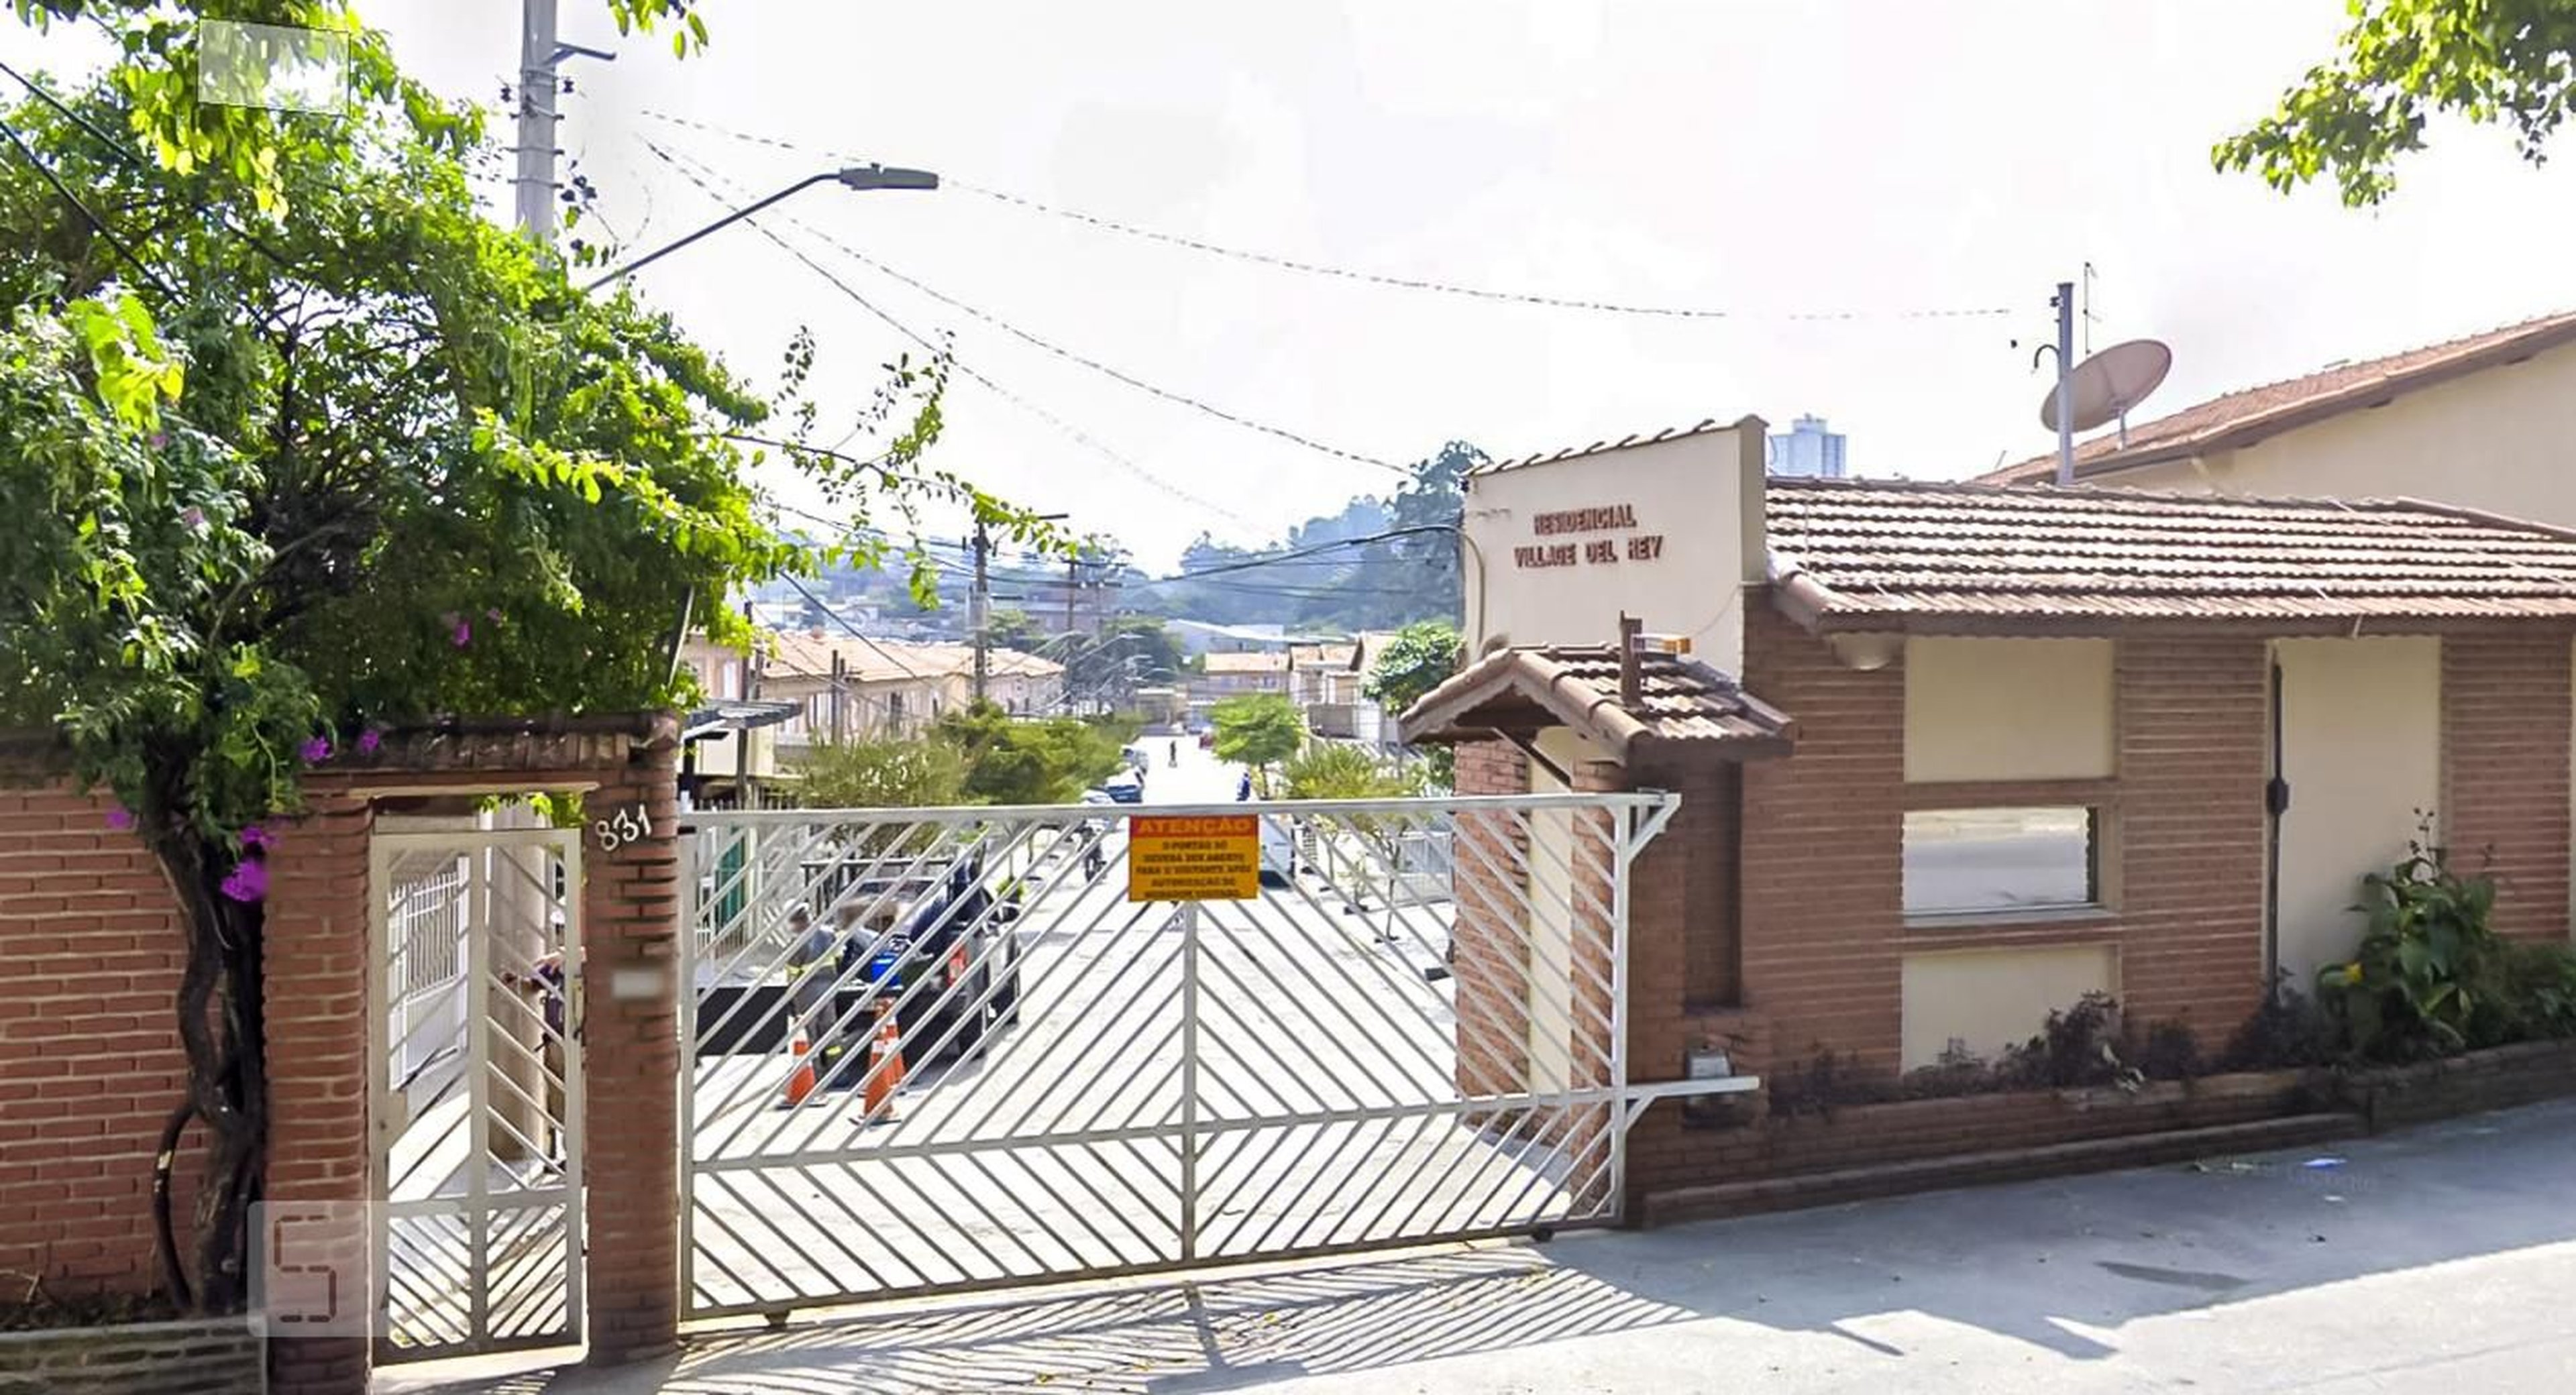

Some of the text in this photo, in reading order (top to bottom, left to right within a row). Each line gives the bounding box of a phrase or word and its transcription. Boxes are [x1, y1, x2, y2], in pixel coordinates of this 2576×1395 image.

[1534, 504, 1637, 535] RESIDENCIAL
[1514, 536, 1664, 567] VILLAGE DEL REY
[596, 803, 651, 851] 831
[1139, 817, 1252, 834] ATENÇÃO
